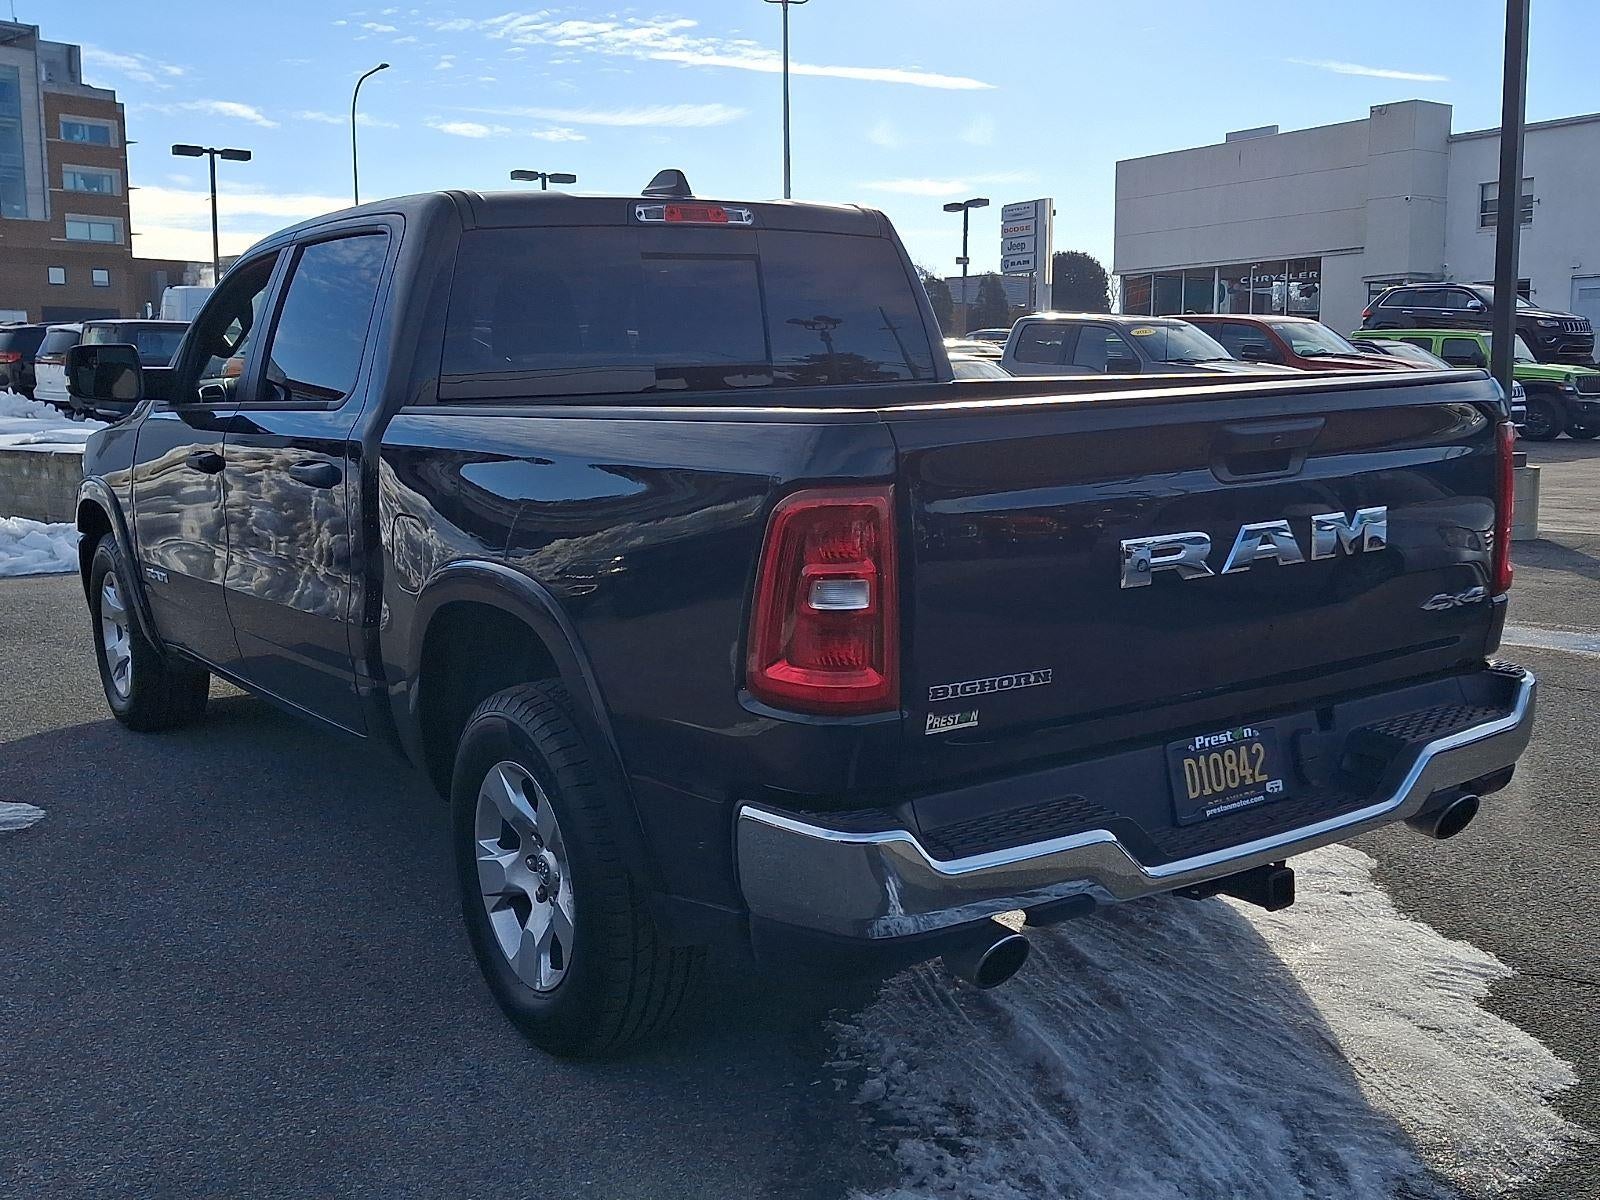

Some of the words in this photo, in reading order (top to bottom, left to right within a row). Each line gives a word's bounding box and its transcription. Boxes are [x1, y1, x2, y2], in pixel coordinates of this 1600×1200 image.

[1004, 225, 1030, 233] DODGE
[1007, 241, 1025, 251] Jeep
[1240, 271, 1318, 284] CHRYSLER
[1120, 505, 1388, 589] RAM
[928, 669, 1052, 702] BIGHORN
[1183, 743, 1268, 799] D10842
[1206, 795, 1265, 817] prestonmotor.com
